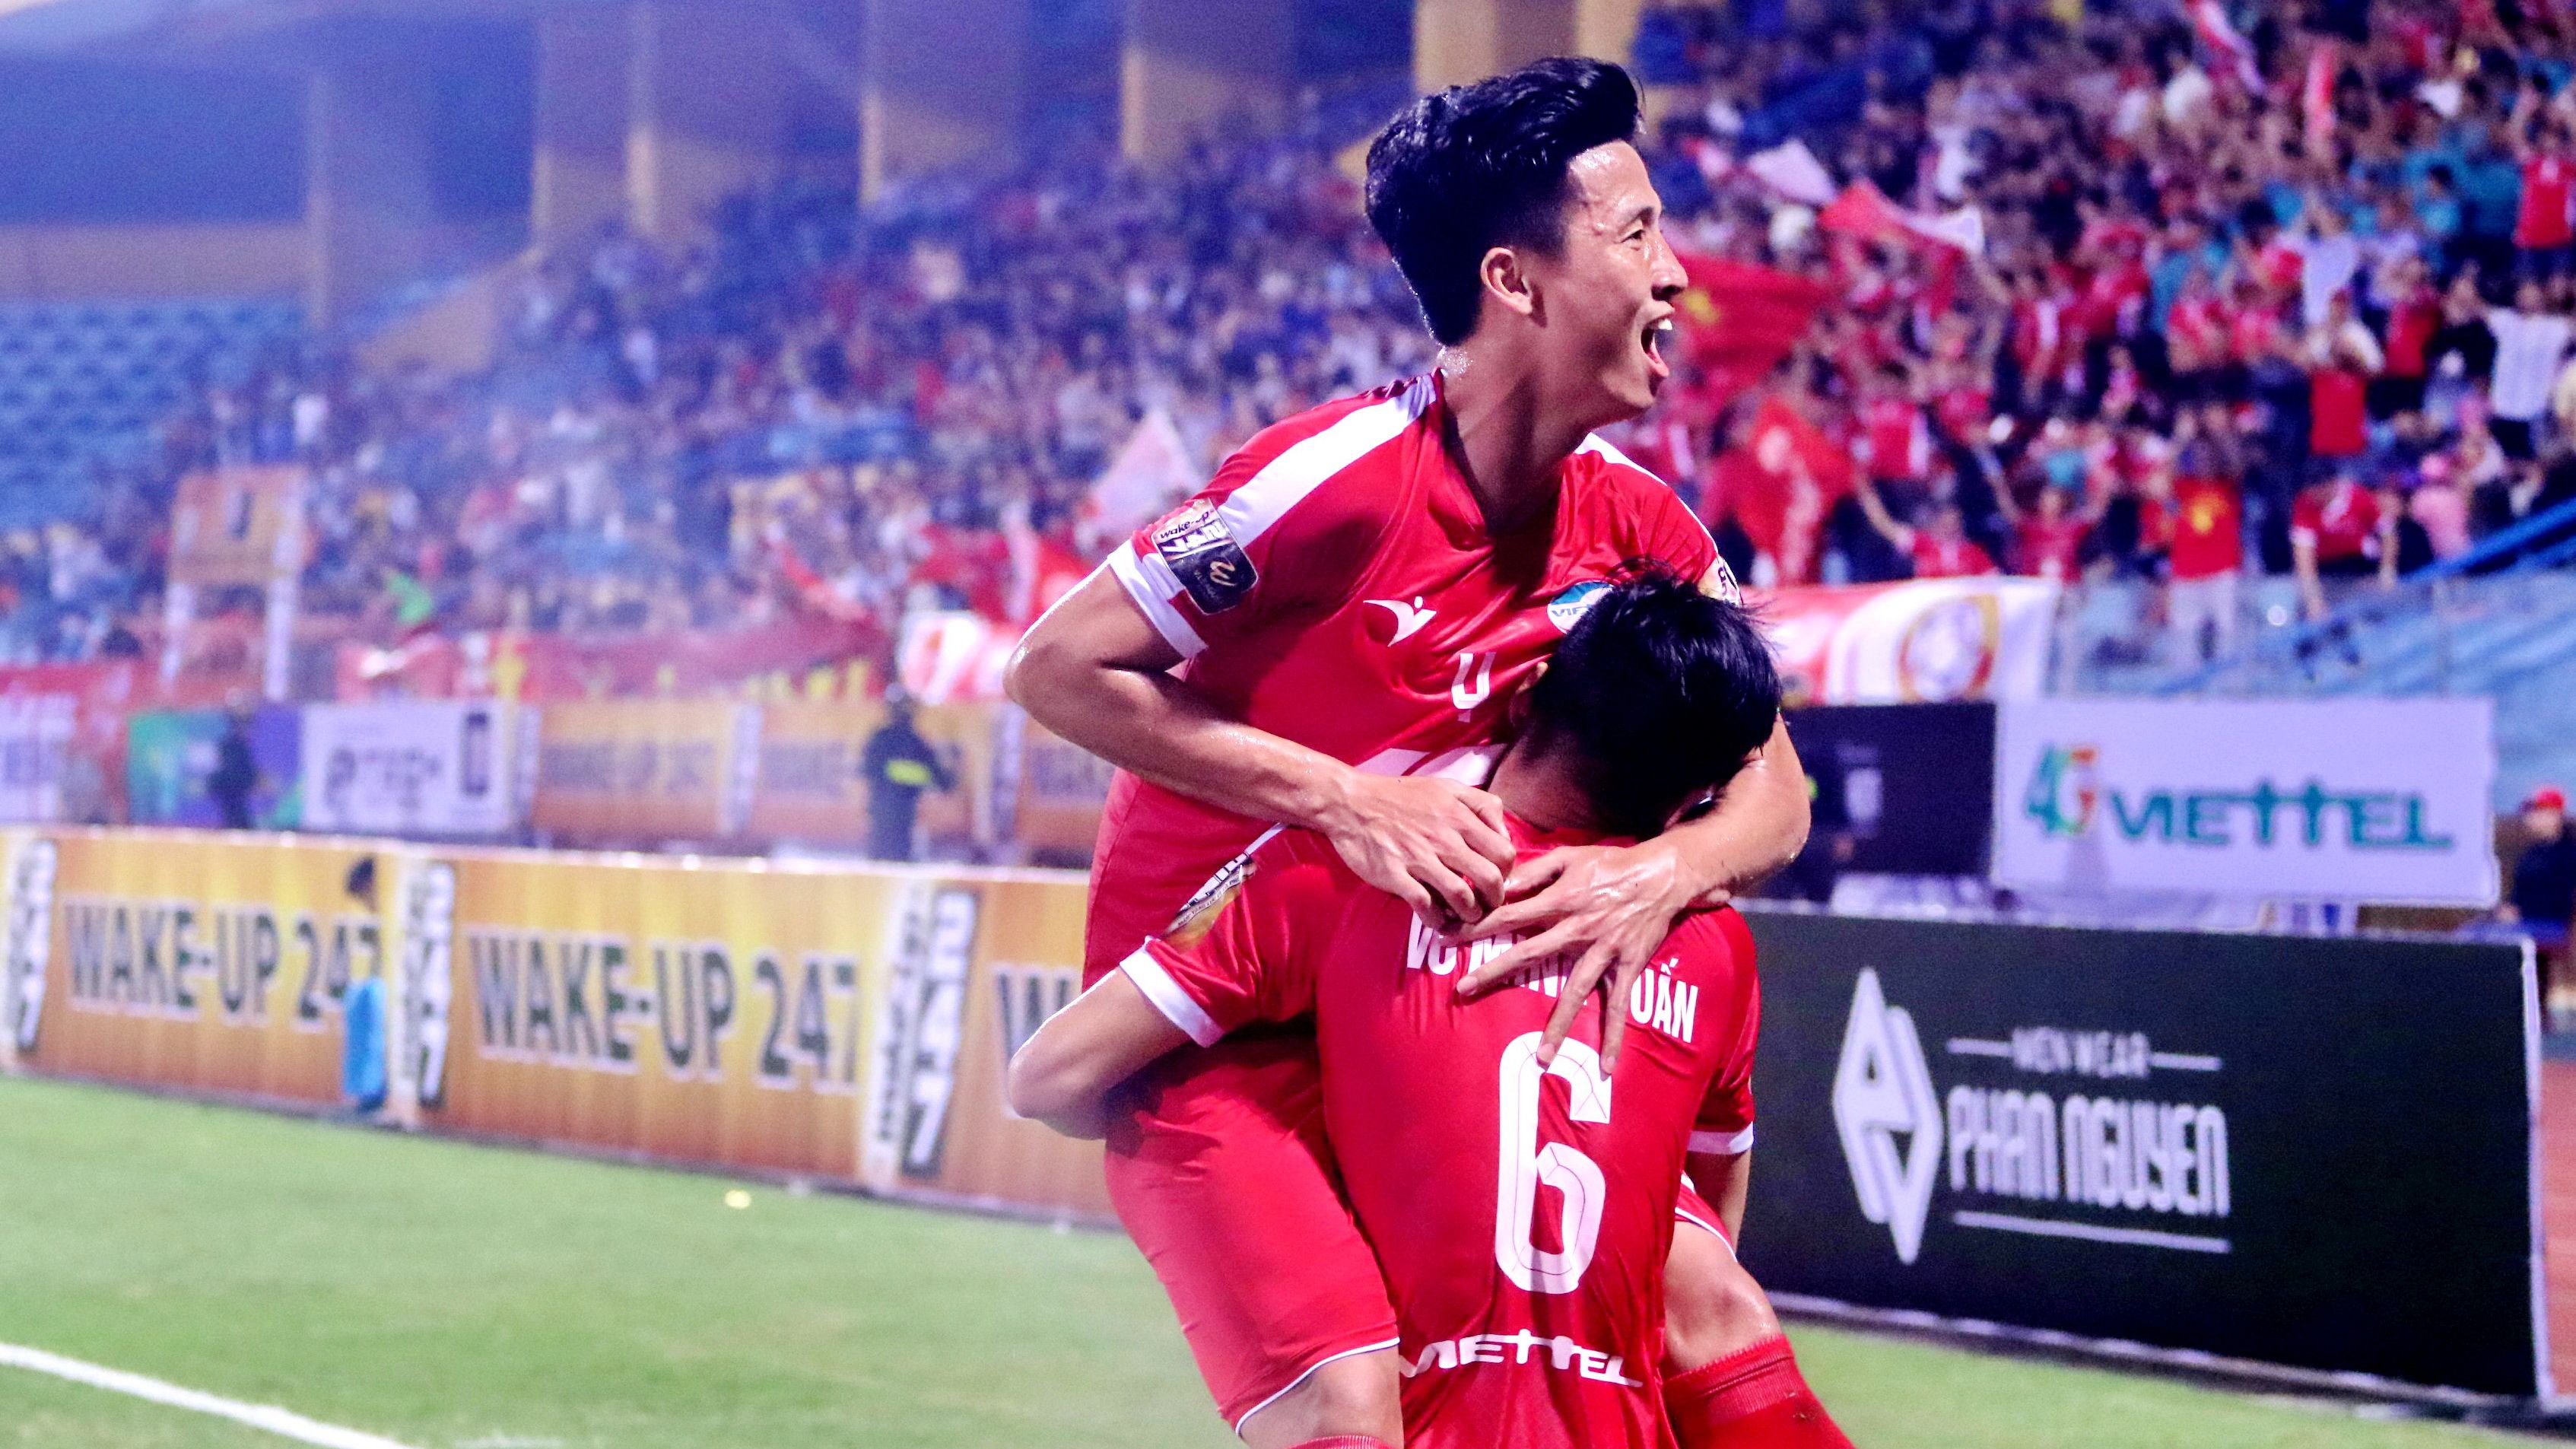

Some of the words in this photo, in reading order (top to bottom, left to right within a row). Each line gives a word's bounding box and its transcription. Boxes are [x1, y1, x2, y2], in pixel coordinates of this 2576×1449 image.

[2110, 776, 2453, 847] VIETTEL
[62, 898, 279, 1024] WAKE-UP
[464, 925, 735, 1081] WAKE-UP
[754, 949, 860, 1091] 247
[1630, 957, 1698, 1044] UẤN
[1495, 1031, 1612, 1295] 6
[1947, 1085, 2058, 1201] PHAN
[2063, 1093, 2231, 1218] NGUYEN
[1399, 1328, 1643, 1388] VIETTEL
